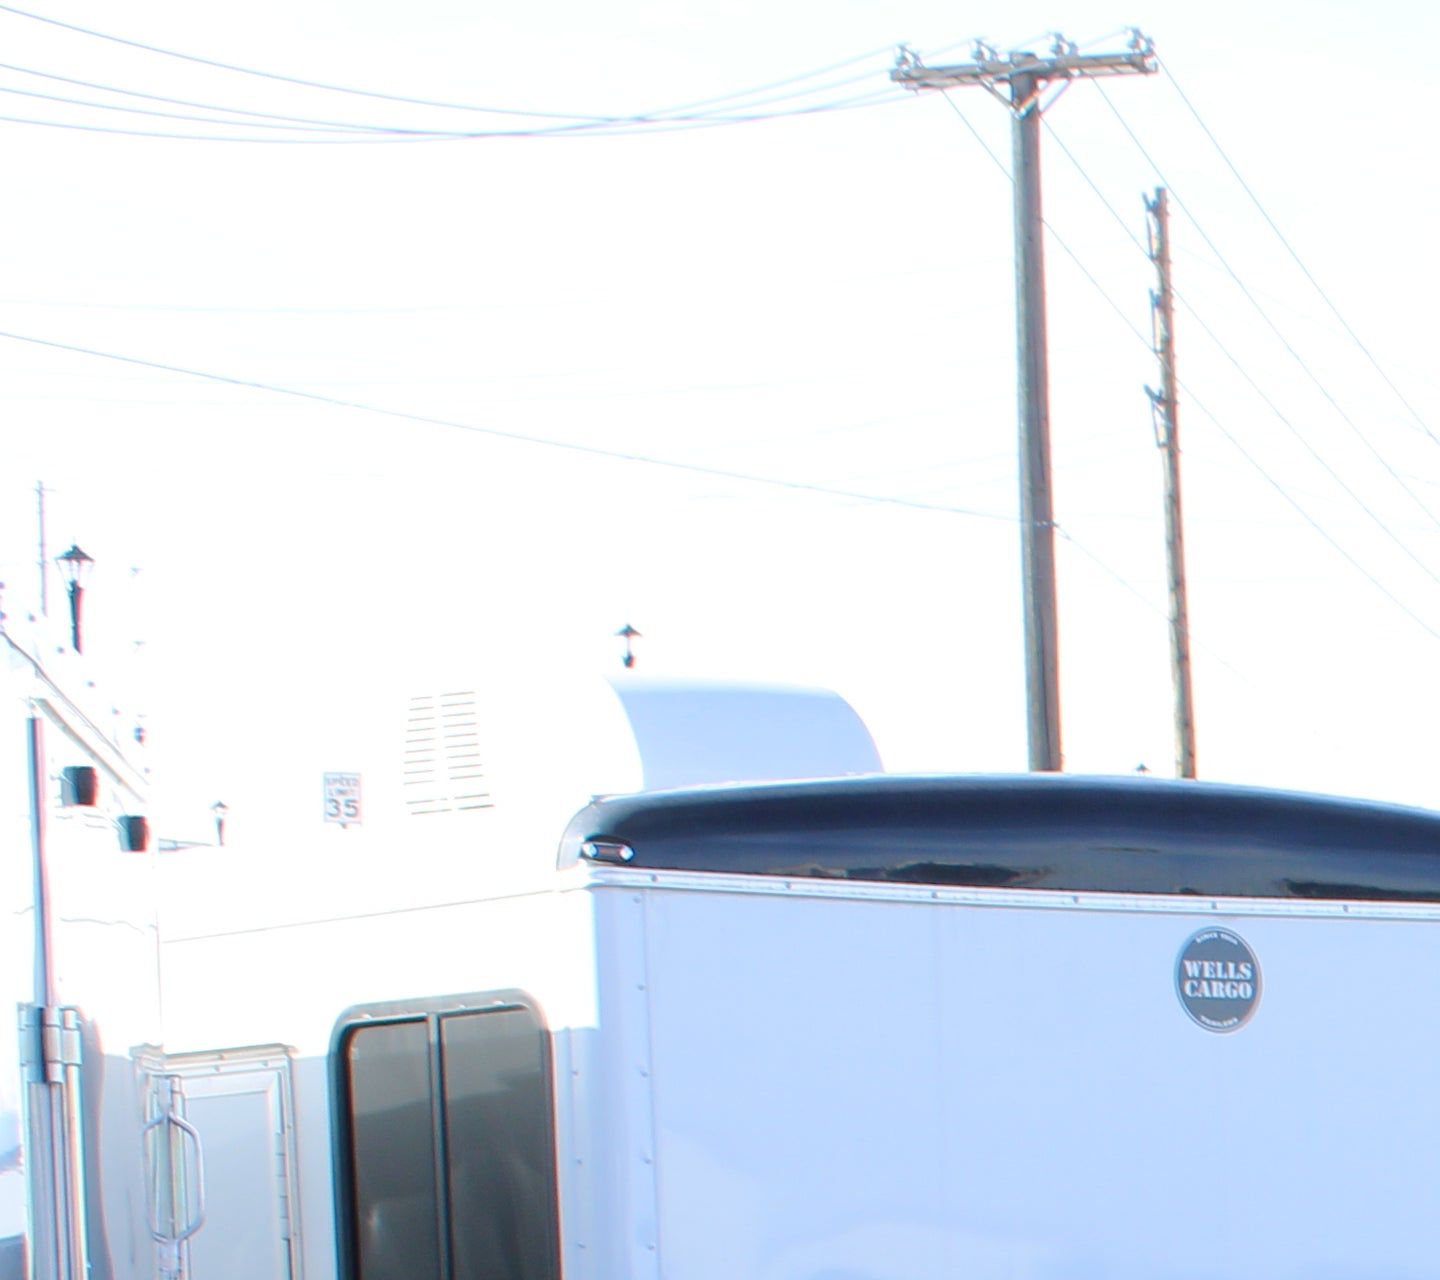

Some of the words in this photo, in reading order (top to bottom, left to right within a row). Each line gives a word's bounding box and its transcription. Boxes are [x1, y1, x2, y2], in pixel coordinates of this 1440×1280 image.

[327, 798, 358, 818] 35
[1183, 959, 1252, 981] WELLS
[1184, 979, 1253, 1000] CARGO
